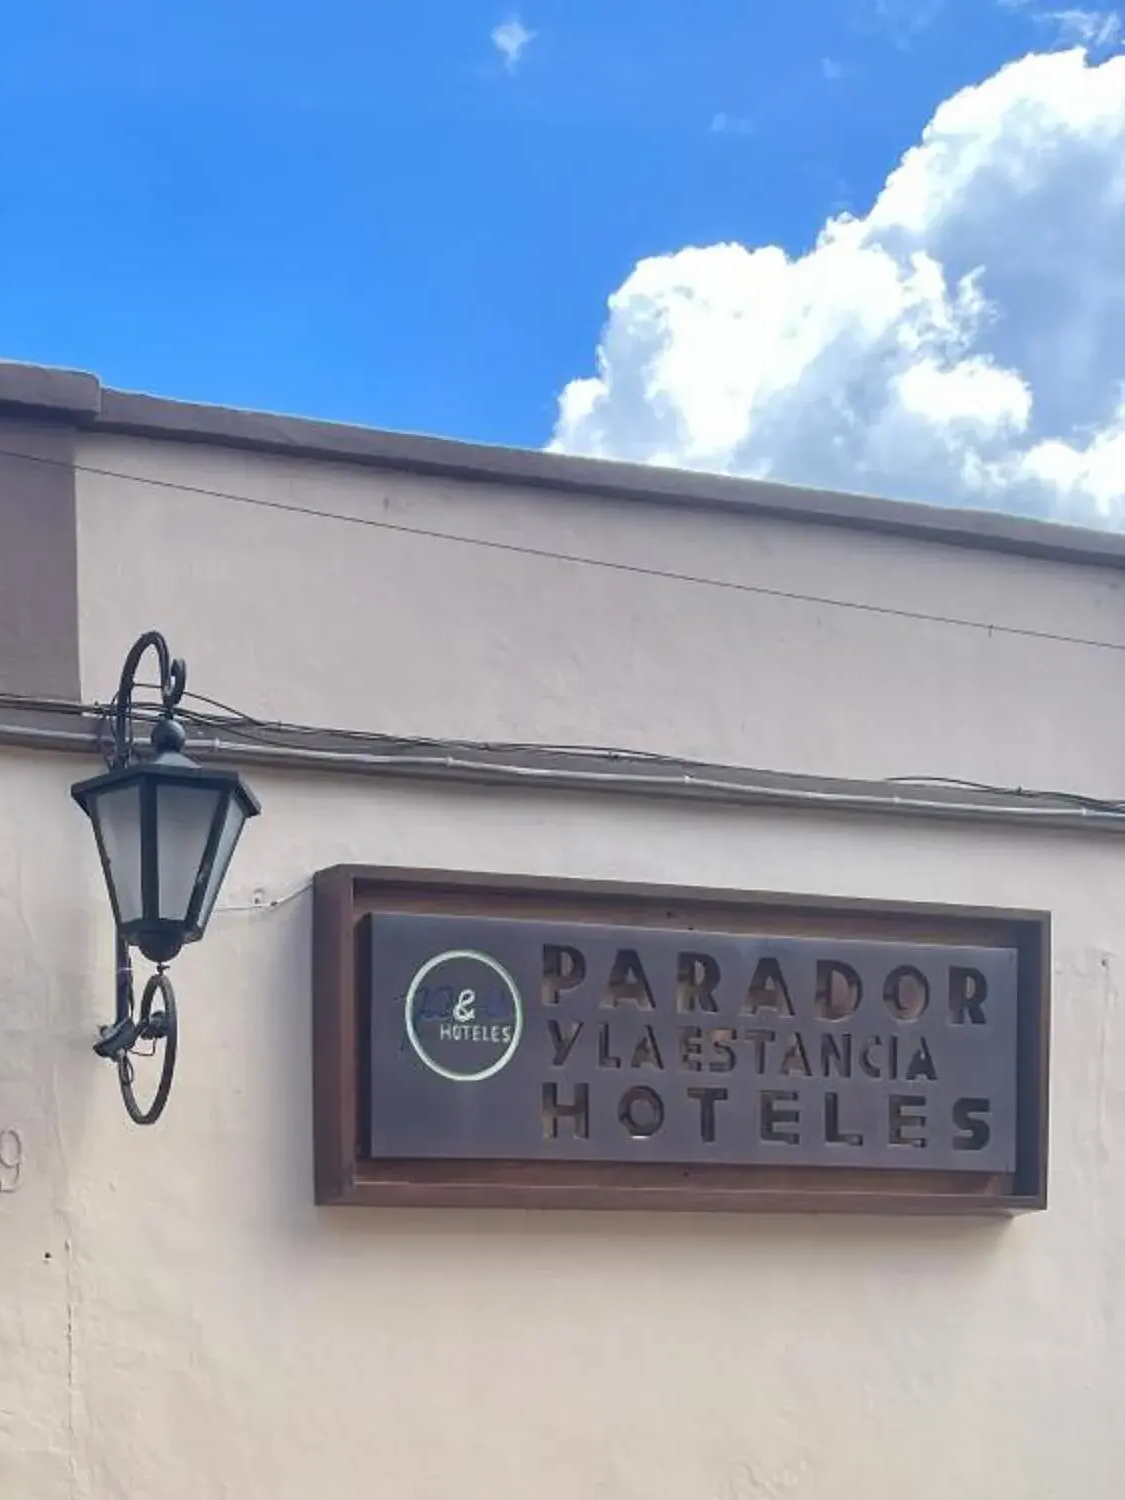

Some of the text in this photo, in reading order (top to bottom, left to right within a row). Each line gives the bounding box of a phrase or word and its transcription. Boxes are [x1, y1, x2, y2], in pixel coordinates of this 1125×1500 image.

[453, 989, 475, 1022] &
[542, 943, 990, 1026] PARADOR
[440, 1023, 511, 1043] HOTELES
[541, 1082, 991, 1151] HOTELES
